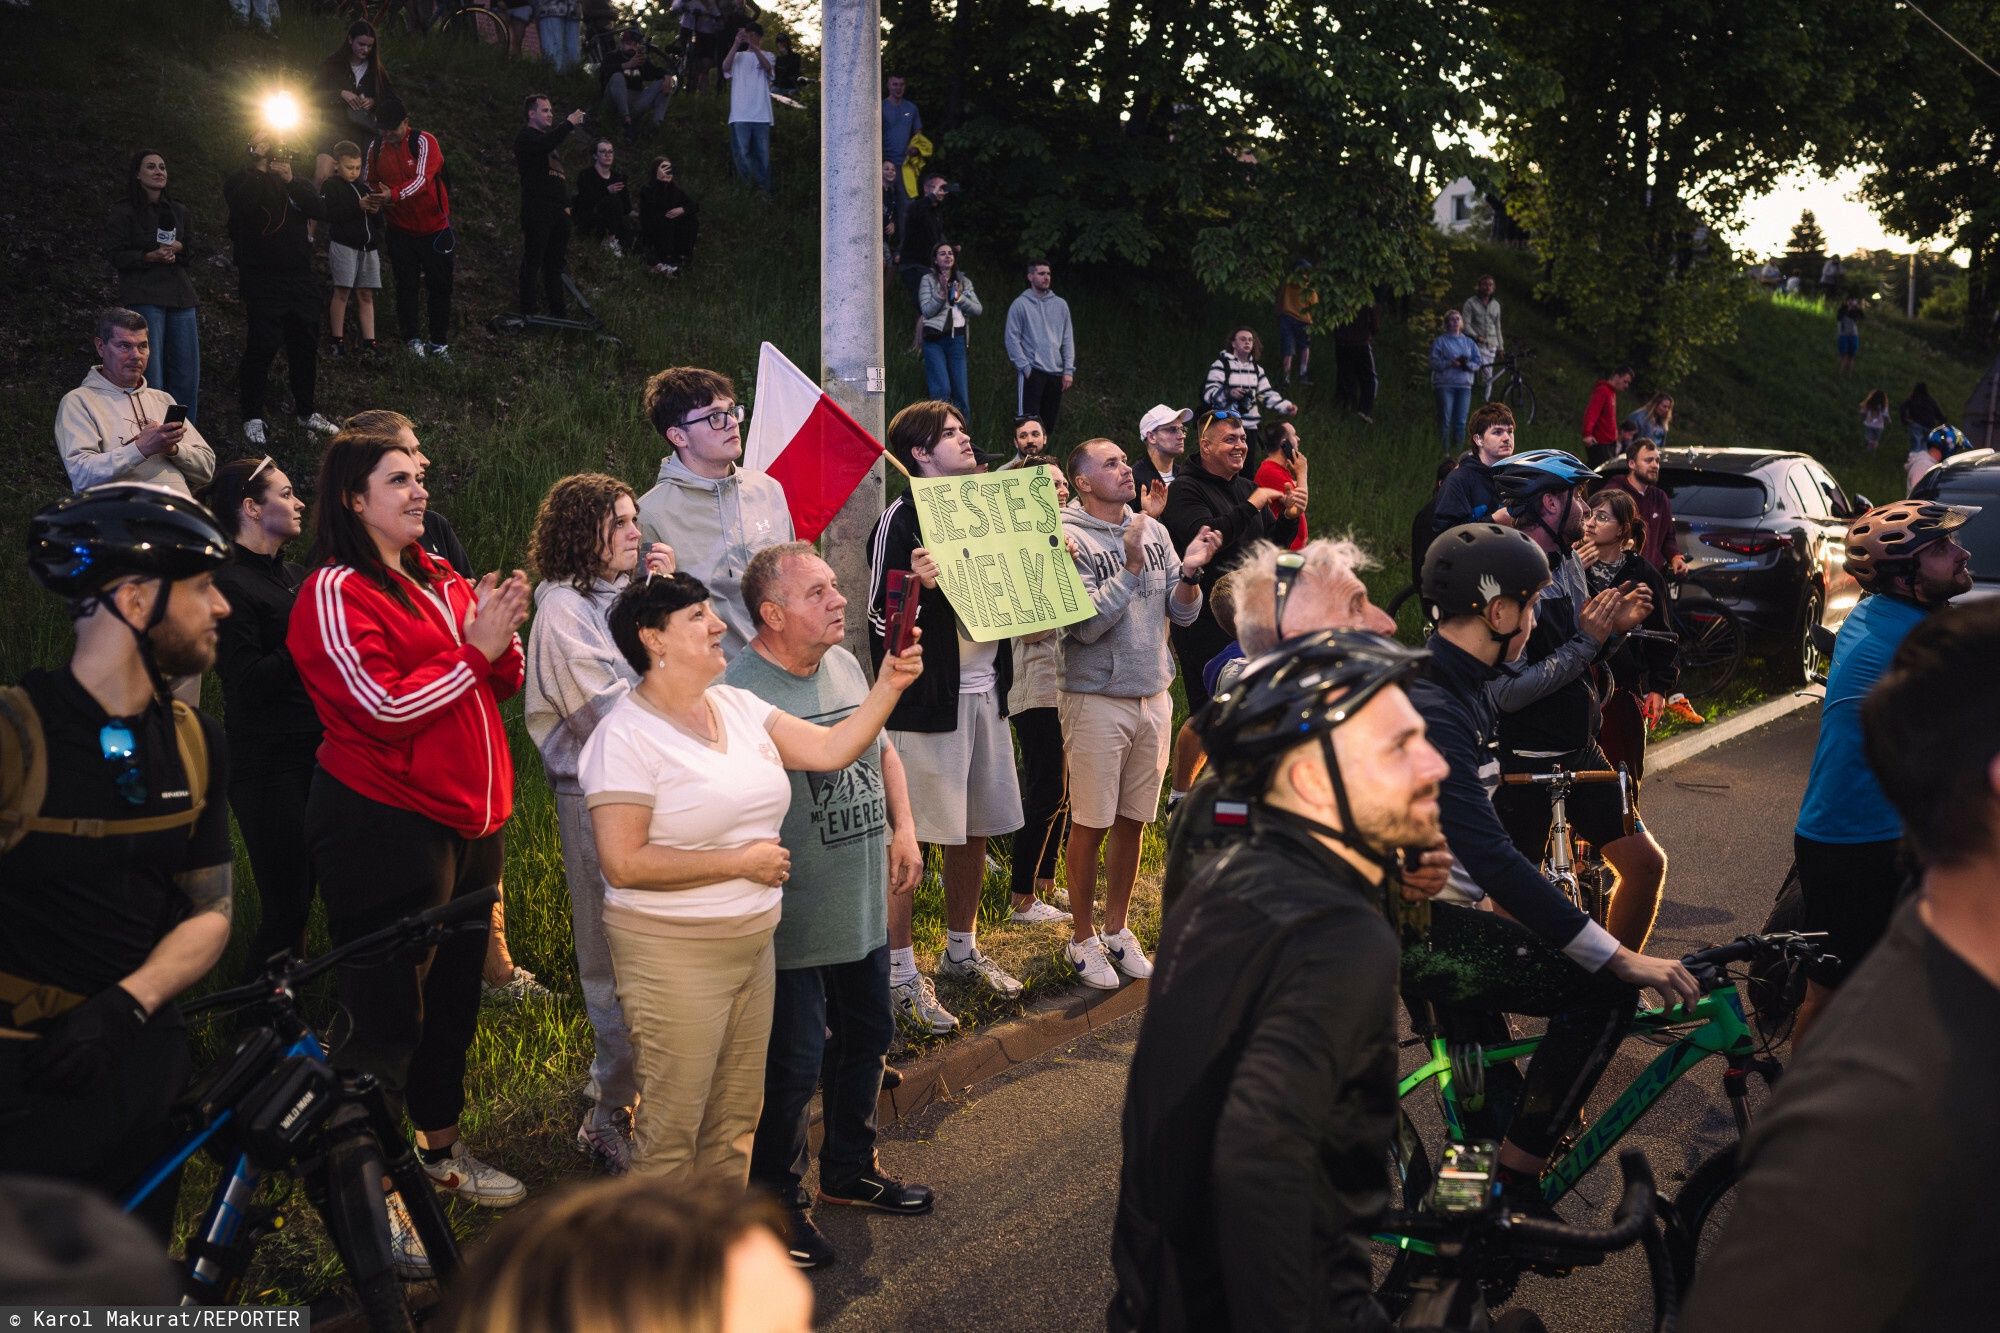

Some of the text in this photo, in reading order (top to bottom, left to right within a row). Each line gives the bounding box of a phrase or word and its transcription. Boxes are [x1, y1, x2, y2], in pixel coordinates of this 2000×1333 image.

[919, 466, 1057, 544] JESTEŚ
[1143, 542, 1166, 573] AR
[828, 797, 885, 835] EVERES
[280, 1107, 300, 1129] WILD
